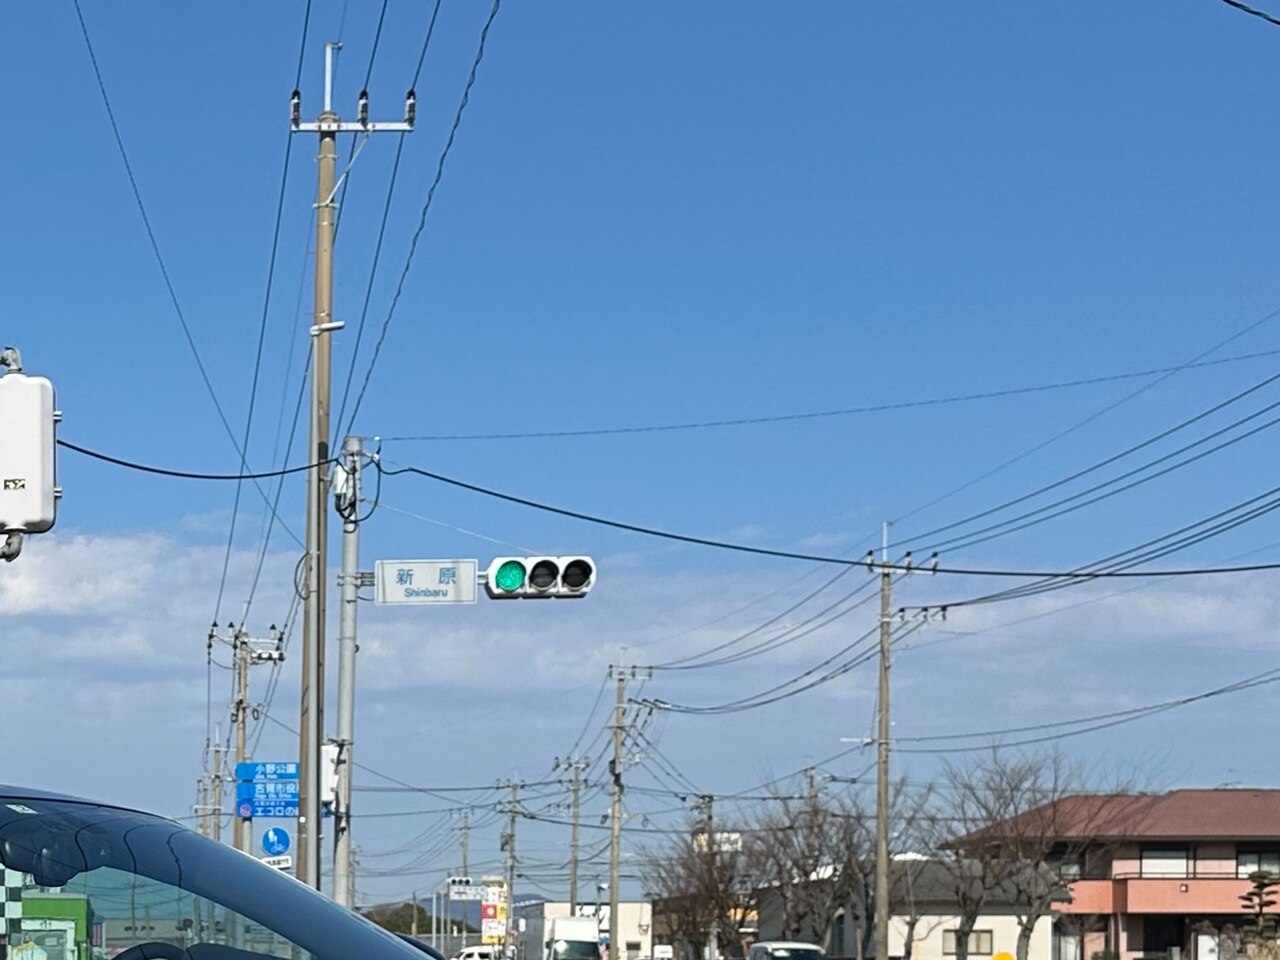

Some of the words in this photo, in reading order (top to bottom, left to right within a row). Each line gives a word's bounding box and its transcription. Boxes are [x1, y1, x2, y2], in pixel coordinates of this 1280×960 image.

[404, 587, 448, 598] Shinbaru
[254, 807, 299, 816] エコロの
